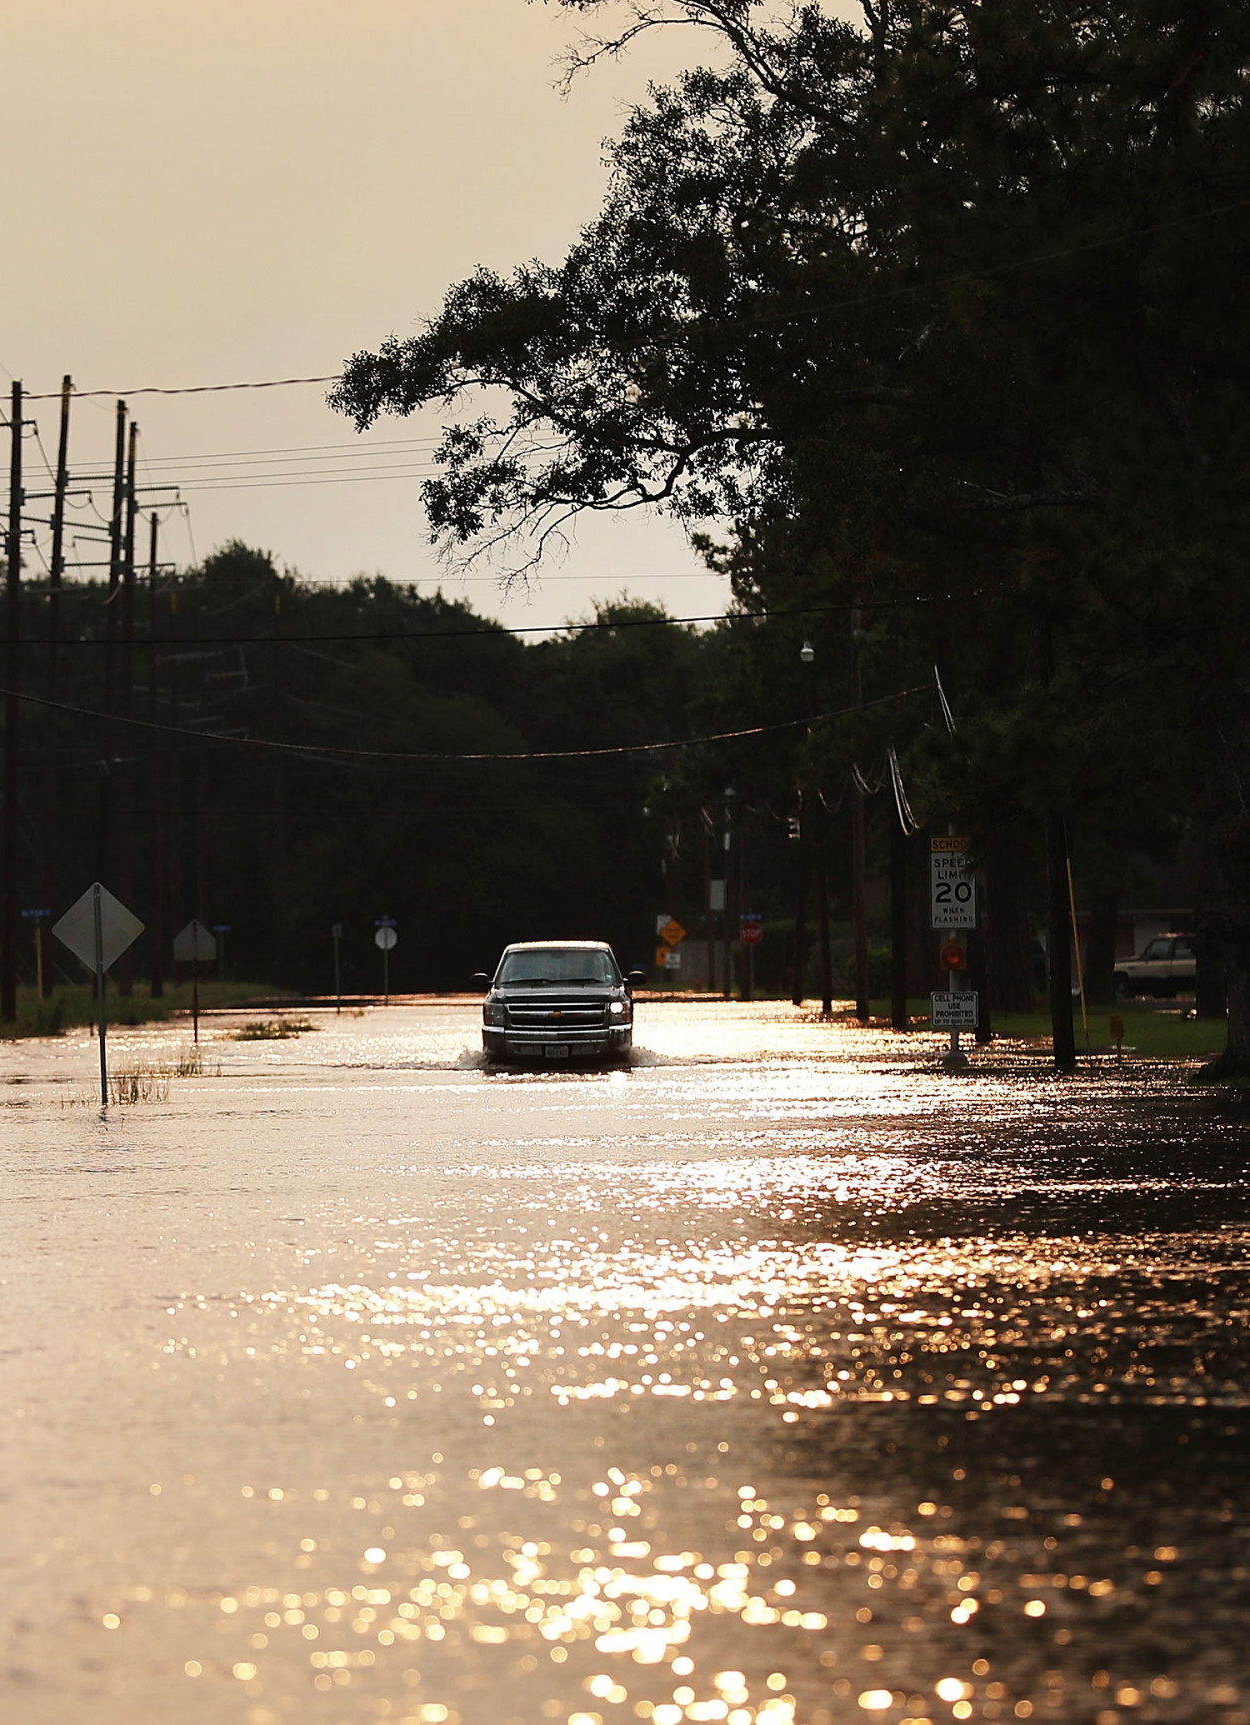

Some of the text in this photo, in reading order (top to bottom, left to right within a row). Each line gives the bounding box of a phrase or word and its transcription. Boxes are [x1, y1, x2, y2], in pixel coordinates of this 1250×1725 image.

[933, 839, 969, 849] SCHOO
[938, 870, 965, 880] LIMI
[935, 882, 972, 903] 20
[934, 916, 973, 924] FLASHING
[741, 928, 761, 938] STOP
[936, 1010, 974, 1018] PROHIBITED
